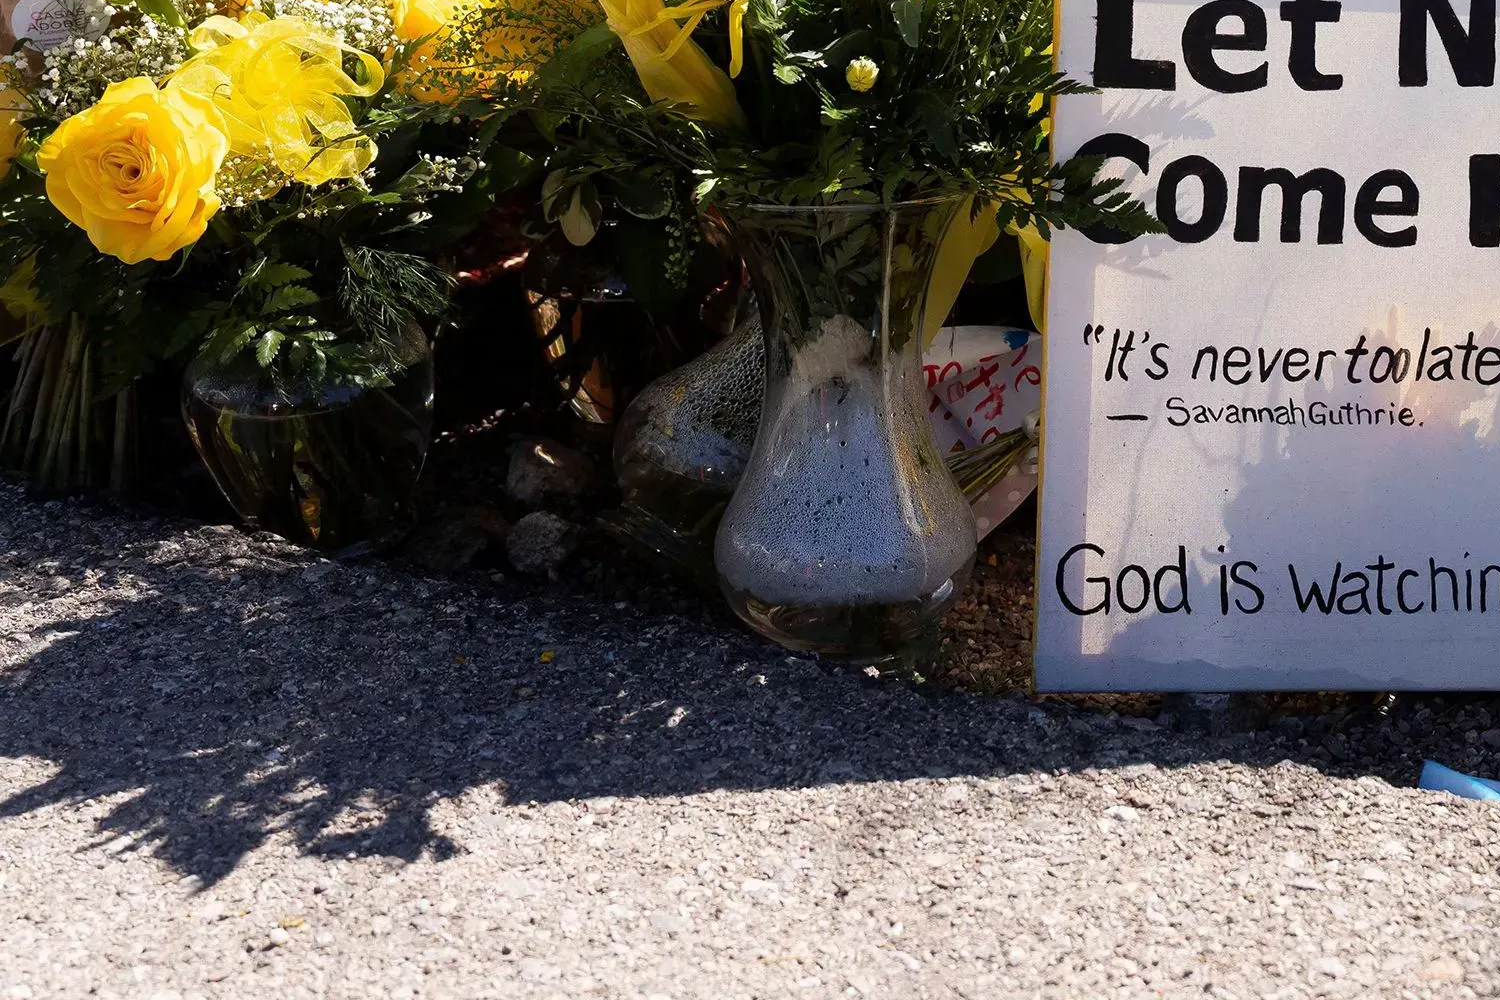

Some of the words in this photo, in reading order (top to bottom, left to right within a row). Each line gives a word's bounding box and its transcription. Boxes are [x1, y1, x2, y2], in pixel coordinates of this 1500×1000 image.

[1073, 132, 1420, 248] Come
[1191, 343, 1336, 385] never
[1166, 397, 1307, 428] Savannah
[1309, 401, 1424, 428] Guthrie.
[1055, 542, 1191, 617] God
[1217, 544, 1265, 617] is
